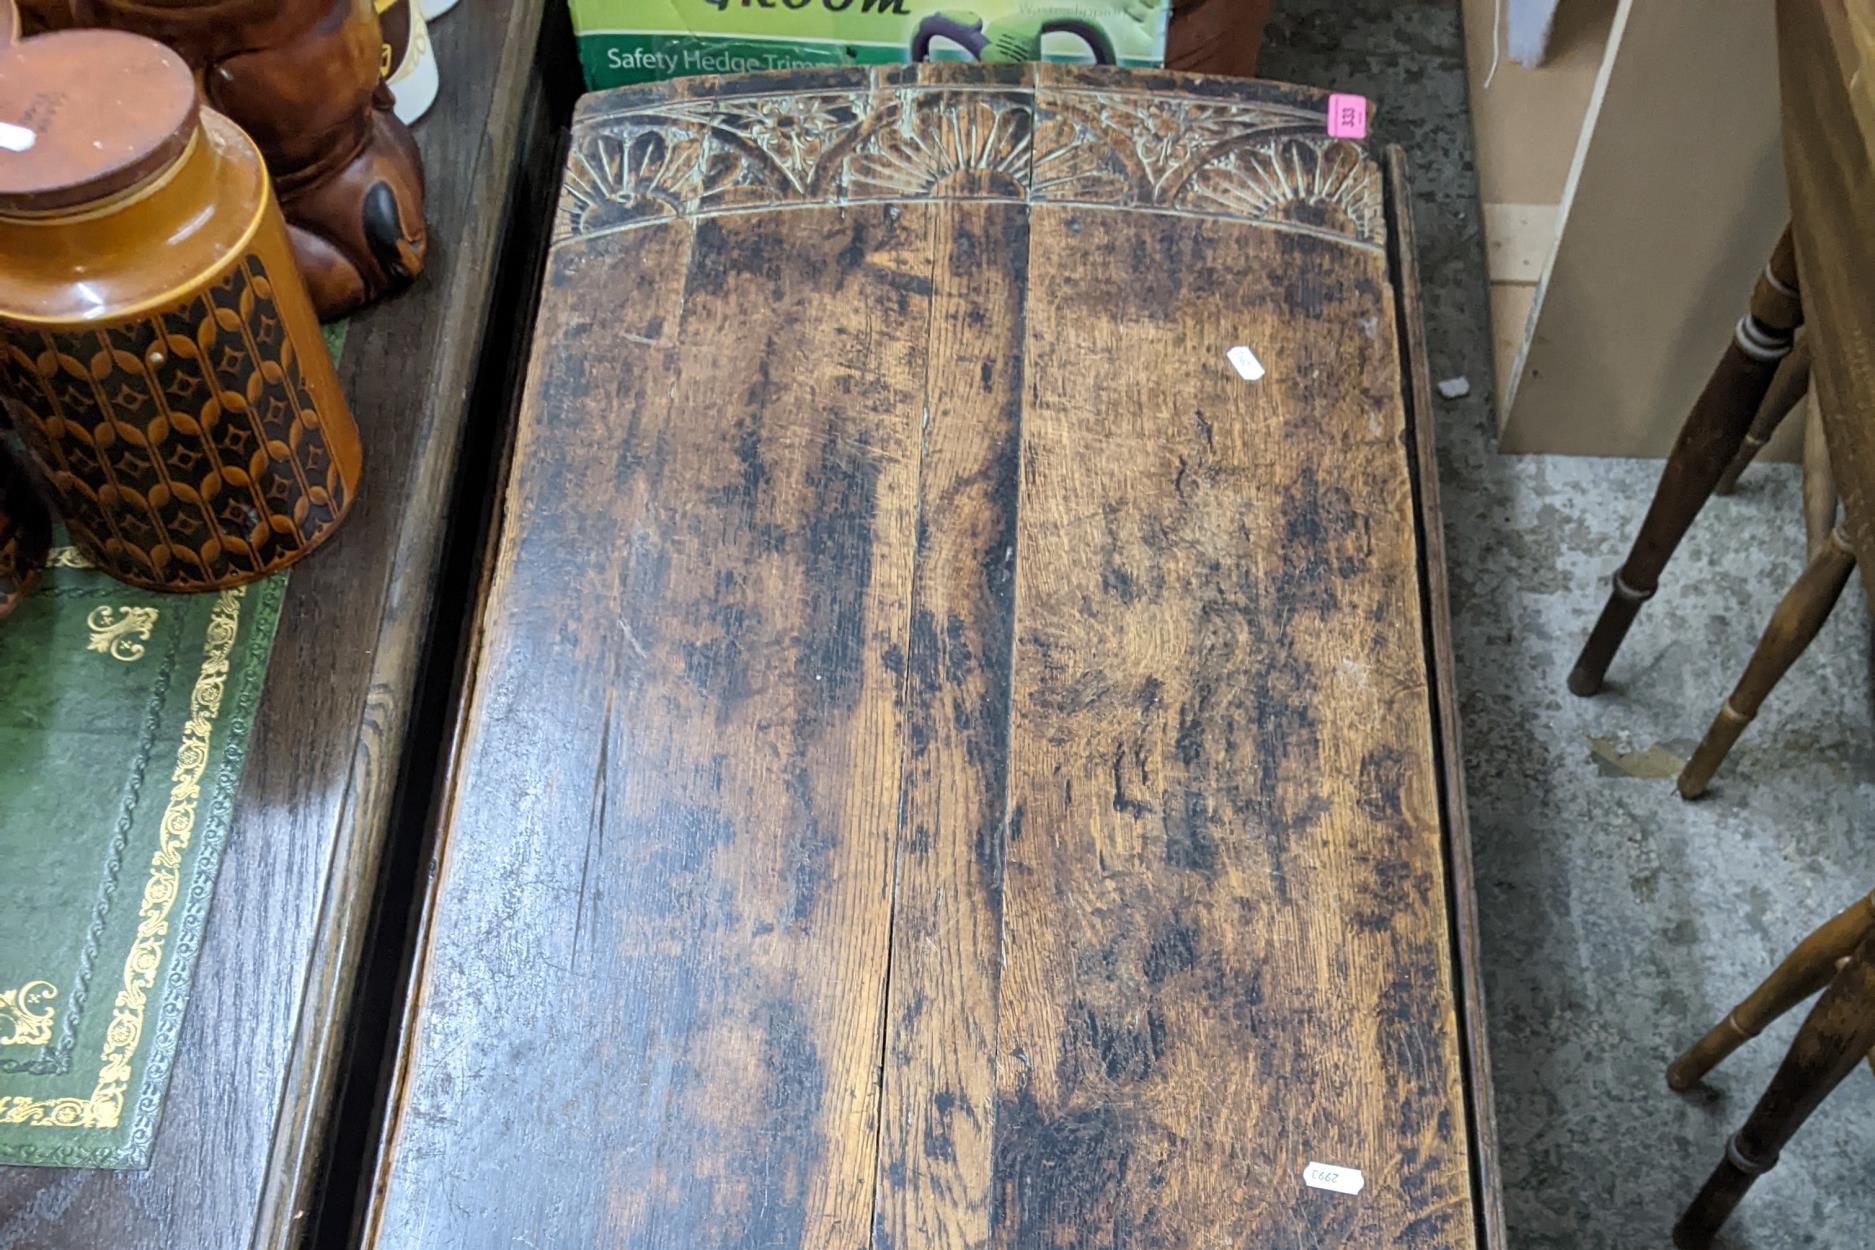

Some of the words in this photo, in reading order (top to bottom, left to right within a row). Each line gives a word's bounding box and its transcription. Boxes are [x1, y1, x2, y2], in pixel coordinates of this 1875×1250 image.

[607, 47, 679, 74] Safety
[682, 49, 760, 74] Hedge
[1312, 1170, 1339, 1183] 2993
